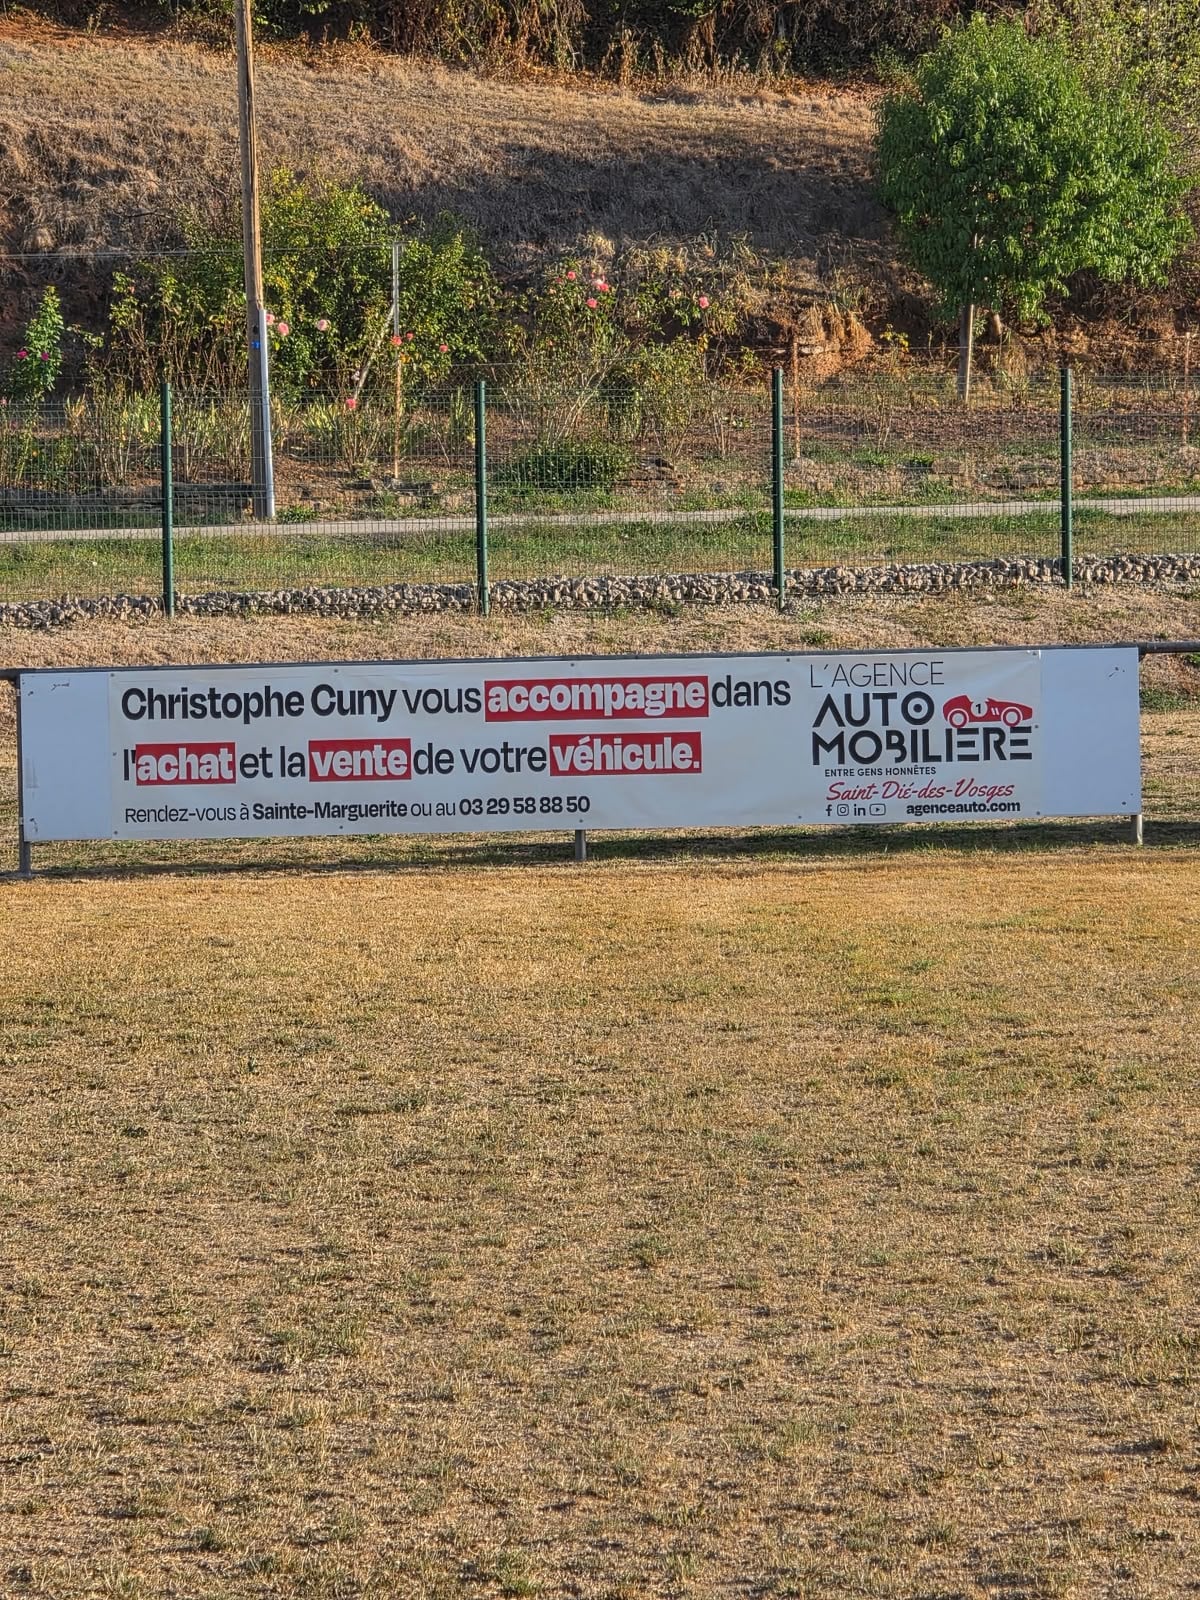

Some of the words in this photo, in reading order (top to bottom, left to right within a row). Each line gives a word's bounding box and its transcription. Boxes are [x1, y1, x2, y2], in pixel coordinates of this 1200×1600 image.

[810, 661, 945, 688] L'AGENCE
[121, 686, 304, 724] Christophe
[310, 684, 398, 722] Cuny
[402, 687, 482, 714] vous
[487, 681, 705, 716] accompagne
[711, 675, 791, 708] dans
[812, 691, 935, 728] AUTO
[975, 703, 981, 714] 1
[123, 748, 234, 781] l'achat
[239, 747, 273, 779] et
[280, 746, 306, 778] la
[311, 745, 407, 777] vente
[413, 743, 454, 775] de
[460, 742, 547, 773] votre
[552, 736, 700, 772] véhicule.
[812, 726, 1032, 765] MOBILIERE
[825, 769, 855, 777] ENTRE
[857, 768, 883, 776] GENS
[886, 765, 936, 776] HONNÊTES
[826, 778, 1015, 804] Saint-Dié-des-Vosges
[125, 805, 236, 823] Rendez-vous
[239, 803, 249, 821] à
[252, 801, 407, 821] Sainte-Marguerite
[410, 804, 434, 817] ou
[435, 803, 456, 817] au
[459, 798, 483, 815] 03
[486, 798, 510, 815] 29
[513, 797, 536, 814] 58
[539, 797, 563, 814] 88
[566, 796, 590, 813] 50
[906, 801, 1021, 816] agenceauto.com
